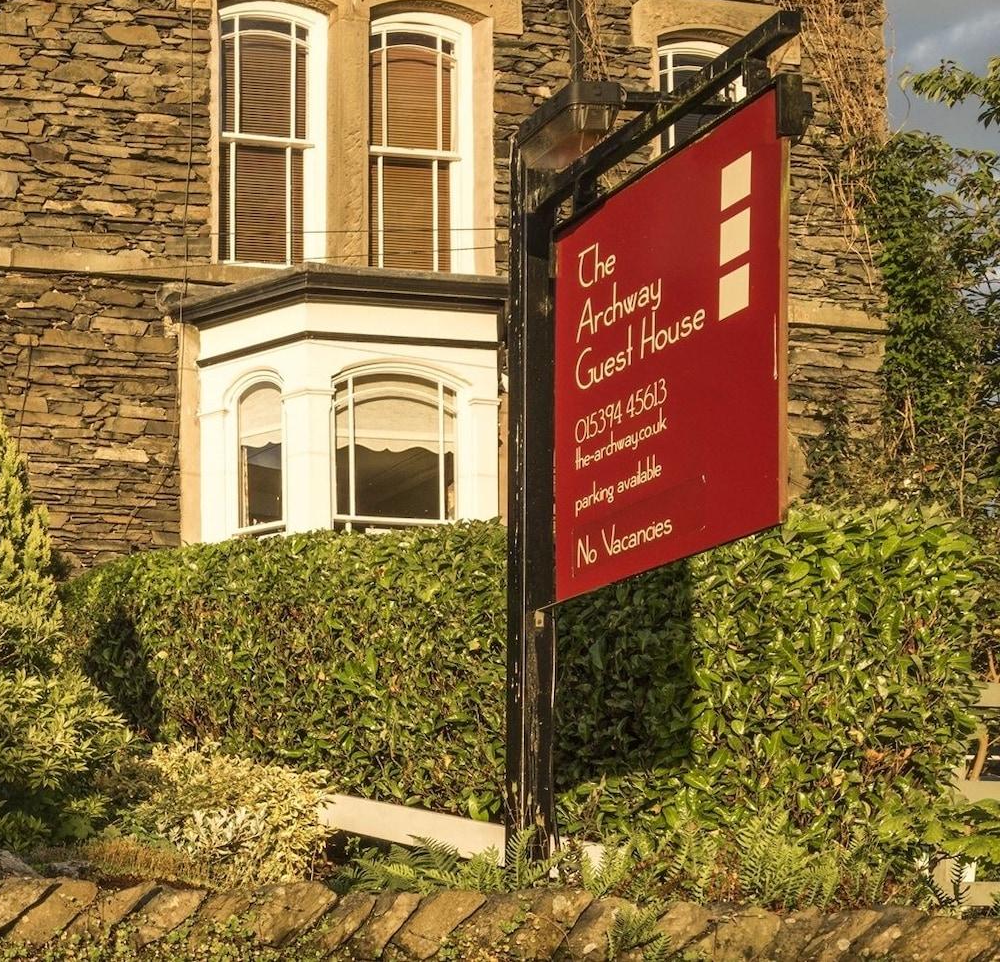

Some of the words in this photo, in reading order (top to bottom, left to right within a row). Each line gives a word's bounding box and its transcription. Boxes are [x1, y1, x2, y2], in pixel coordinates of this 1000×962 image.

[577, 242, 617, 288] The
[575, 277, 663, 344] Archway
[575, 324, 634, 390] Guest
[640, 308, 706, 359] House
[574, 400, 623, 444] 015394
[625, 377, 668, 418] 45613
[574, 407, 668, 471] the-archway.co.uk
[574, 480, 615, 517] parking
[616, 453, 663, 494] available
[576, 534, 598, 568] No
[601, 518, 673, 556] Vacancies
